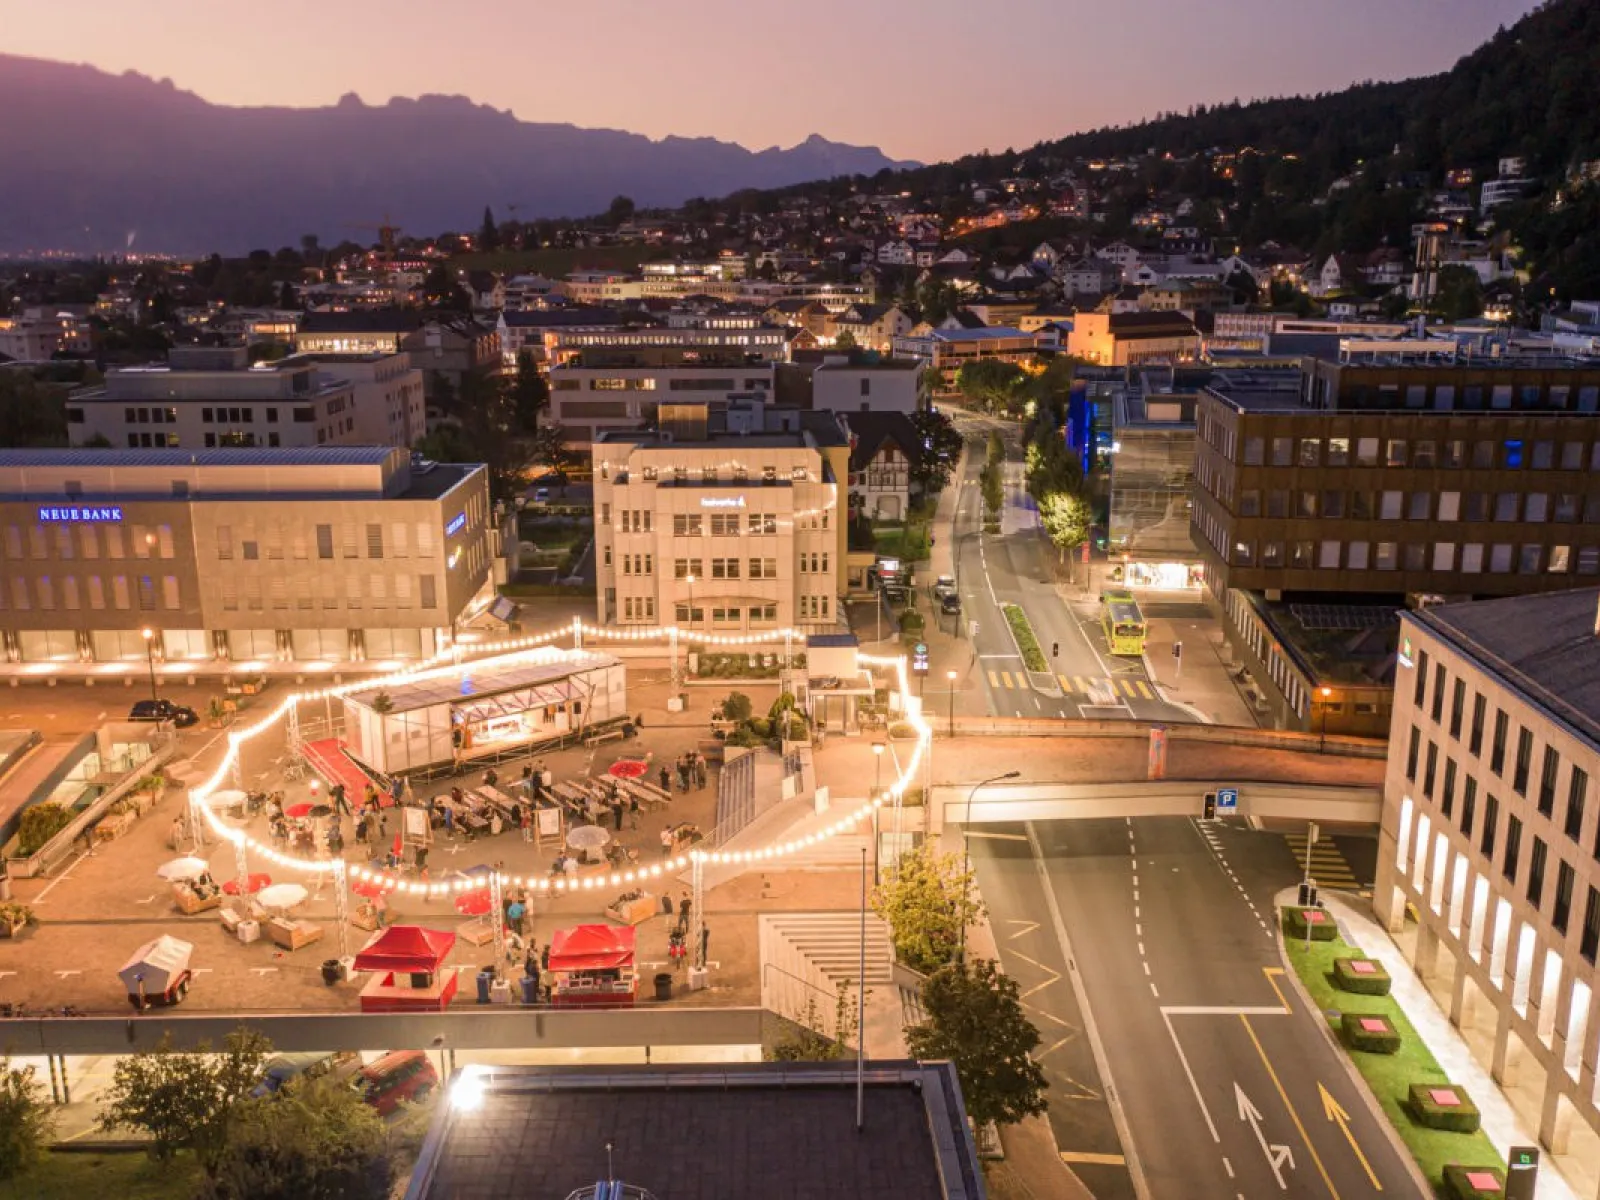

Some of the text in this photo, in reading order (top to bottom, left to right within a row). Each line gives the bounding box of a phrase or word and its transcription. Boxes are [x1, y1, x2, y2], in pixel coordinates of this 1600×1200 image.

[40, 508, 122, 520] NEUE BANK
[1222, 793, 1232, 805] P
